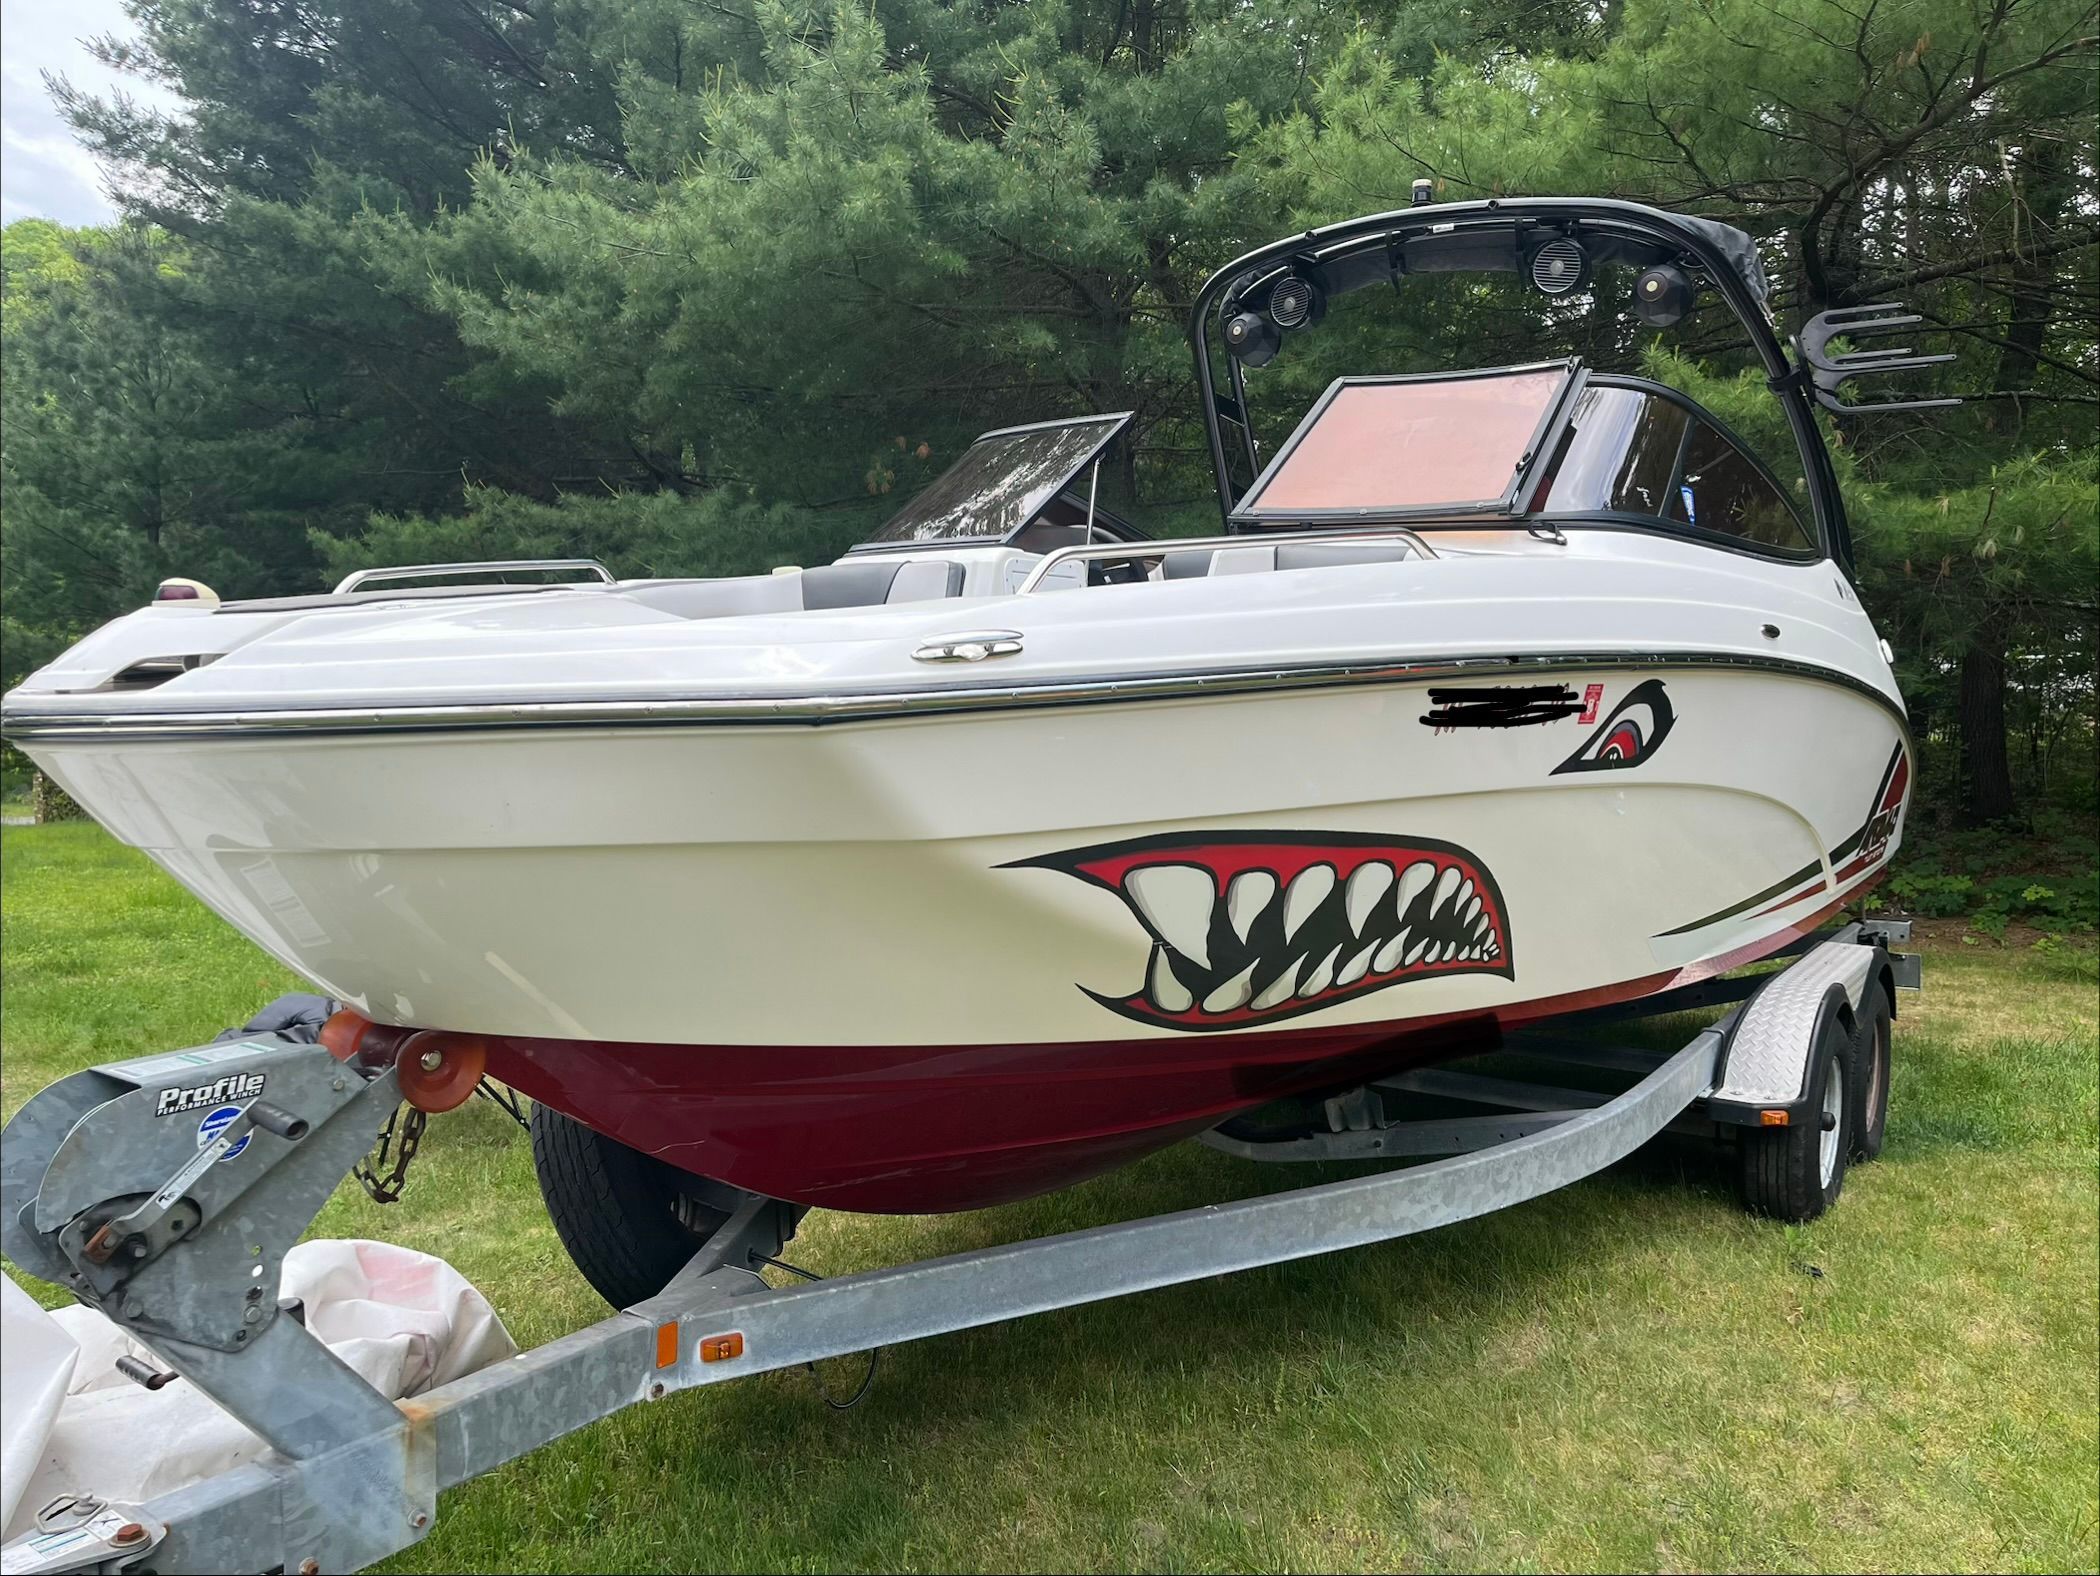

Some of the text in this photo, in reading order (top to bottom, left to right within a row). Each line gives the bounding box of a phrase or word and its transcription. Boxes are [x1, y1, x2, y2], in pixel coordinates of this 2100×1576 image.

[157, 1089, 260, 1116] PERFORMANCE WINCH
[158, 1073, 265, 1110] Profile
